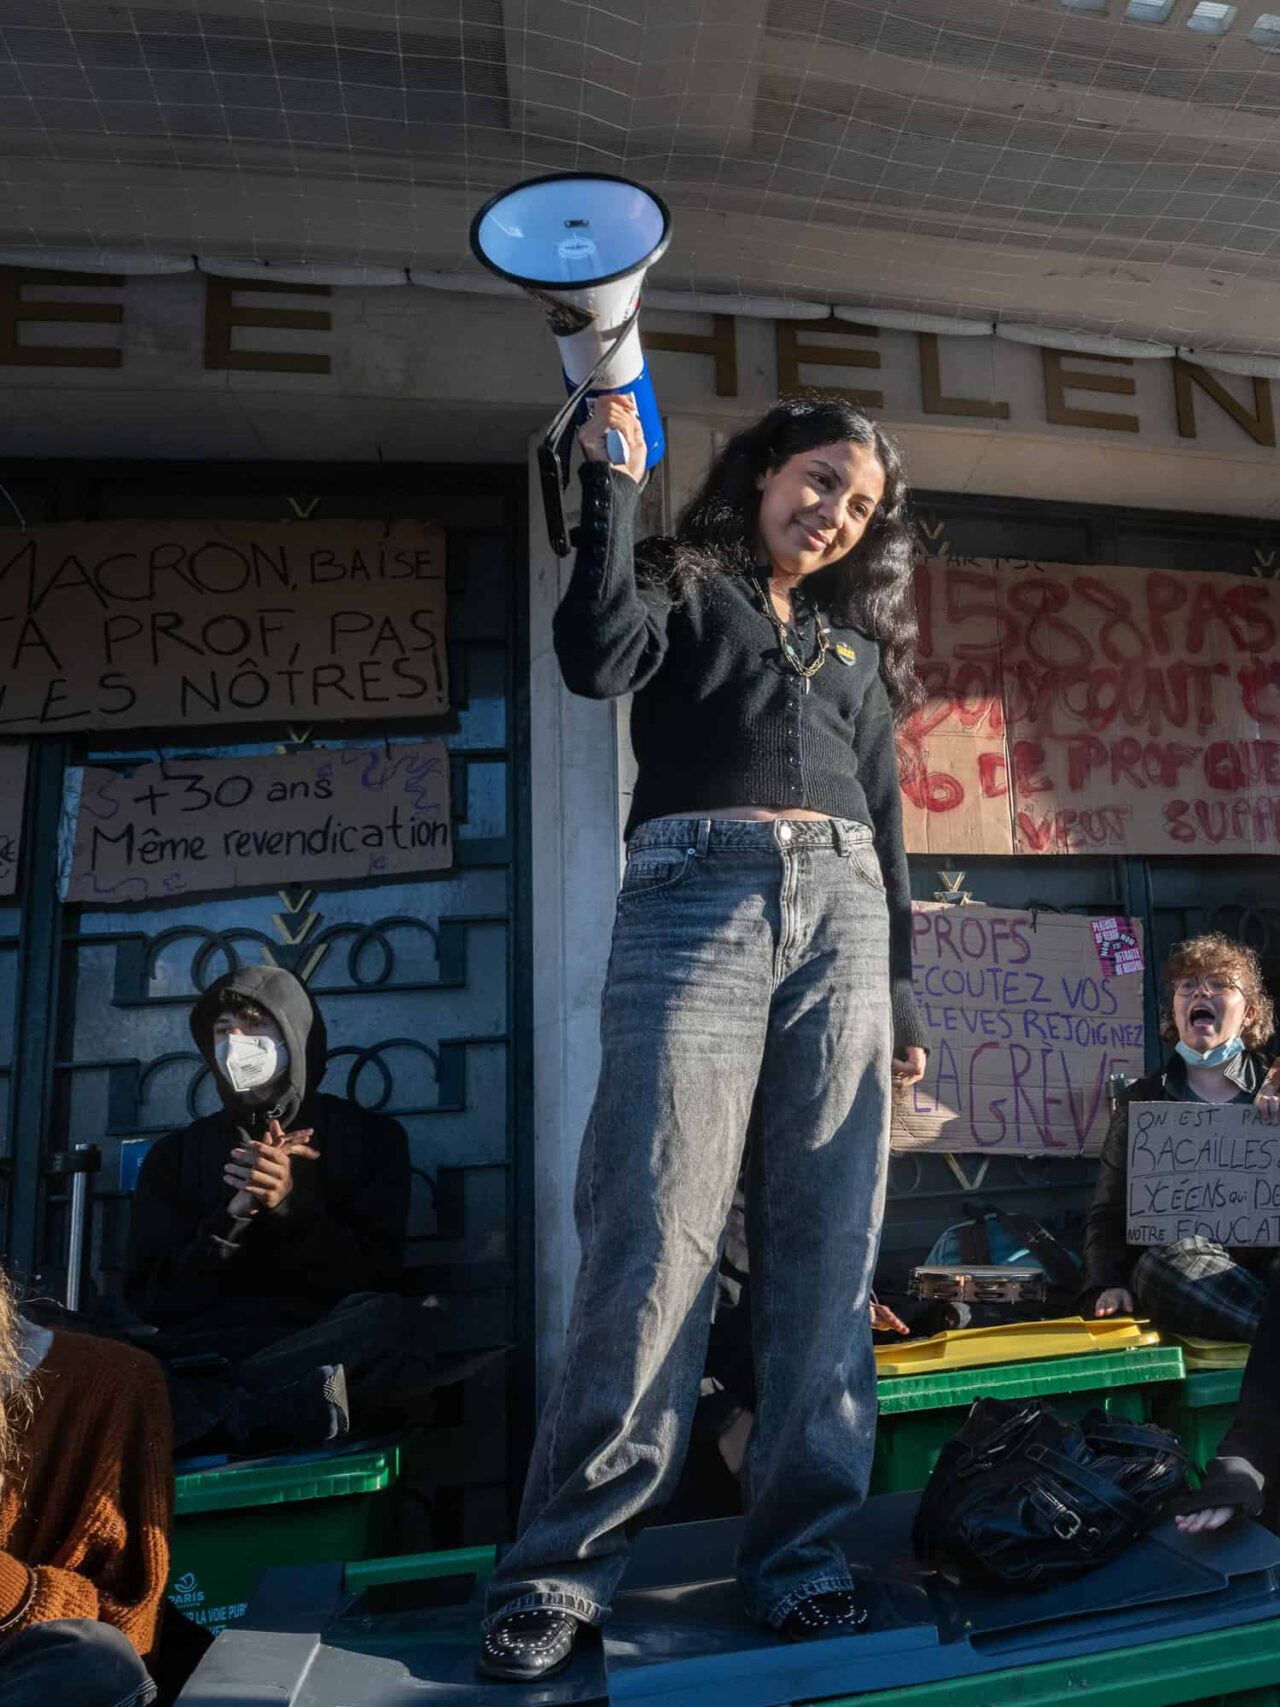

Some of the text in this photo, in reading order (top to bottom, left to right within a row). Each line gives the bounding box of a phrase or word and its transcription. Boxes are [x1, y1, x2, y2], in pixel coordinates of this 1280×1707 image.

[0, 615, 62, 670] A
[330, 610, 437, 656] PAS
[914, 563, 1151, 671] 1588
[1144, 572, 1277, 655] PAS
[267, 777, 334, 803] ans
[978, 741, 1054, 798] DE
[90, 807, 449, 870] Même revendication
[912, 911, 1031, 964] PROFS
[918, 997, 1012, 1038] LEVES
[1062, 977, 1118, 1015] VOS
[914, 1038, 962, 1112] LA
[1137, 1111, 1167, 1130] ON
[1179, 1108, 1220, 1127] EST
[1127, 1225, 1165, 1242] NOTRE
[195, 1608, 207, 1625] LA
[207, 1606, 228, 1623] VOIE
